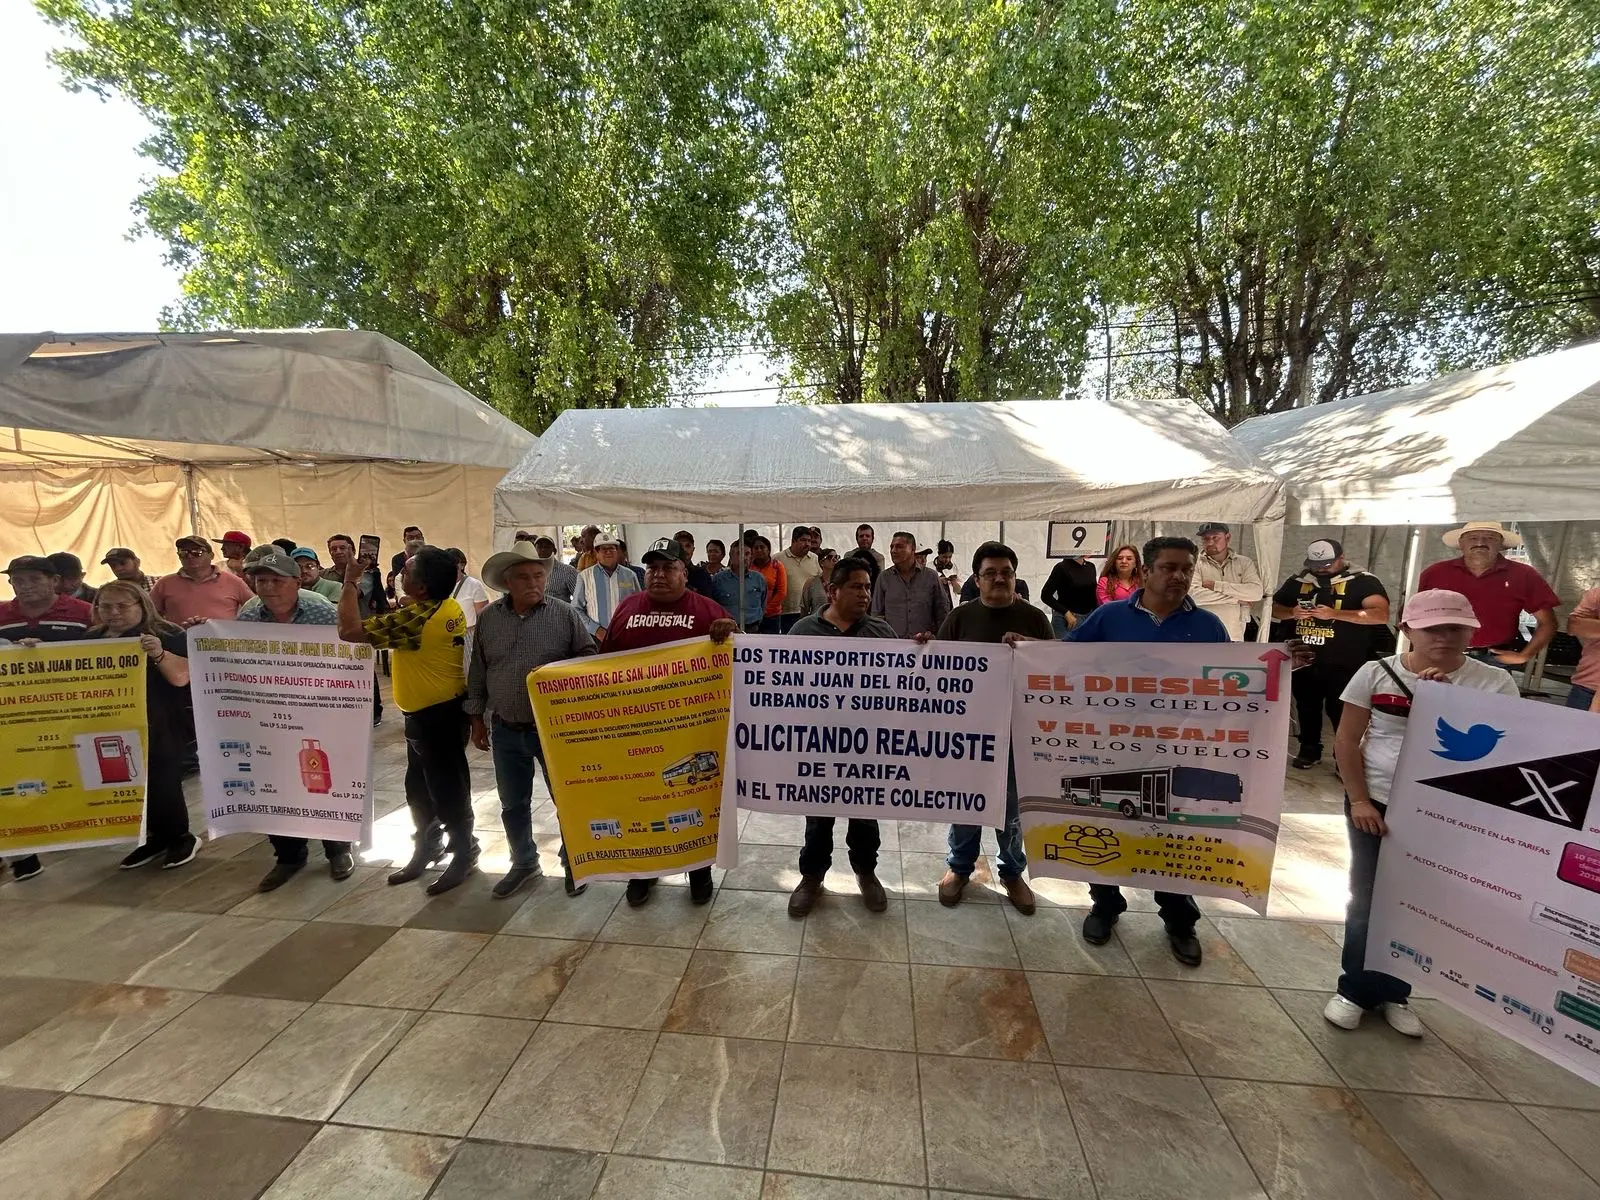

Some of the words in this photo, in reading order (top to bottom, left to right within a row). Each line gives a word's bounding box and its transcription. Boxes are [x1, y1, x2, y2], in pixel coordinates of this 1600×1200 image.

[1072, 526, 1086, 547] 9
[626, 614, 695, 629] AEROPOSTALE
[11, 662, 24, 674] DE
[28, 660, 45, 673] SAN
[47, 658, 71, 671] JUAN
[76, 658, 93, 670] DEL
[96, 656, 116, 669] RIO,
[119, 654, 139, 667] QRO
[733, 648, 762, 663] LOS
[770, 649, 916, 669] TRANSPORTISTAS
[922, 656, 988, 673] UNIDOS
[224, 672, 257, 683] PEDIMOS
[259, 676, 271, 684] UN
[274, 676, 312, 687] REAJUSTE
[314, 679, 323, 687] DE
[326, 679, 354, 689] TARIFA
[536, 672, 608, 694] TRASNPORTISTAS
[612, 670, 622, 683] DE
[626, 667, 643, 682] SAN
[646, 663, 668, 679] JUAN
[672, 660, 688, 675] DEL
[712, 652, 729, 667] QRO
[745, 670, 765, 685] DE
[772, 670, 807, 687] SAN
[810, 672, 854, 687] JUAN
[860, 674, 891, 689] DEL
[896, 672, 931, 694] RÍO,
[937, 676, 973, 693] QRO
[20, 692, 63, 703] REAJUSTE
[66, 692, 78, 700] DE
[80, 688, 113, 699] TARIFA
[1027, 674, 1073, 691] EL
[1084, 675, 1247, 697] DIESEL
[218, 710, 250, 718] EJEMPLOS
[566, 709, 605, 723] PEDIMOS
[607, 708, 619, 717] UN
[622, 701, 665, 715] REAJUSTE
[668, 698, 679, 709] DE
[682, 692, 714, 706] TARIFA
[750, 692, 829, 708] URBANOS
[835, 695, 846, 709] Y
[851, 696, 967, 715] SUBURBANOS
[1024, 694, 1071, 705] POR
[1086, 696, 1135, 708] LOS
[1150, 698, 1269, 713] CIELOS,
[1064, 722, 1101, 735] EL
[1108, 724, 1249, 743] PASAJE
[628, 744, 663, 756] EJEMPLOS
[876, 728, 995, 763] REAJUSTE
[1030, 736, 1079, 749] POR
[1092, 740, 1141, 752] LOS
[1155, 744, 1269, 760] SUELOS
[798, 762, 825, 777] DE
[834, 762, 911, 781] TARIFA
[662, 792, 670, 800] de
[752, 782, 771, 799] EL
[776, 784, 885, 805] TRANSPORTE
[890, 787, 986, 811] COLECTIVO
[227, 804, 236, 813] EL
[238, 804, 268, 813] REAJUSTE
[270, 806, 301, 815] TARIFARIO
[302, 808, 310, 816] ES
[310, 809, 338, 819] URGENTE
[339, 812, 344, 820] Y
[1157, 832, 1195, 841] PARA
[1424, 810, 1444, 821] FALTA
[1446, 817, 1456, 825] DE
[1458, 821, 1485, 834] AJUSTE
[1487, 830, 1498, 838] EN
[1500, 834, 1515, 843] LAS
[1516, 838, 1551, 855] TARIFAS
[596, 849, 626, 858] REAJUSTE
[628, 847, 661, 857] TARIFARIO
[664, 846, 672, 854] ES
[672, 836, 706, 851] URGENTE
[707, 834, 712, 842] Y
[1166, 842, 1212, 852] MEJOR
[1166, 862, 1212, 871] MEJOR
[1216, 858, 1245, 867] UNA
[1413, 855, 1435, 867] ALTOS
[1437, 864, 1468, 880] COSTOS
[1469, 876, 1522, 899] OPERATIVOS
[1406, 903, 1427, 916] FALTA
[1428, 913, 1438, 921] DE
[1475, 936, 1493, 948] CON
[1494, 945, 1558, 977] AUTORIDADES
